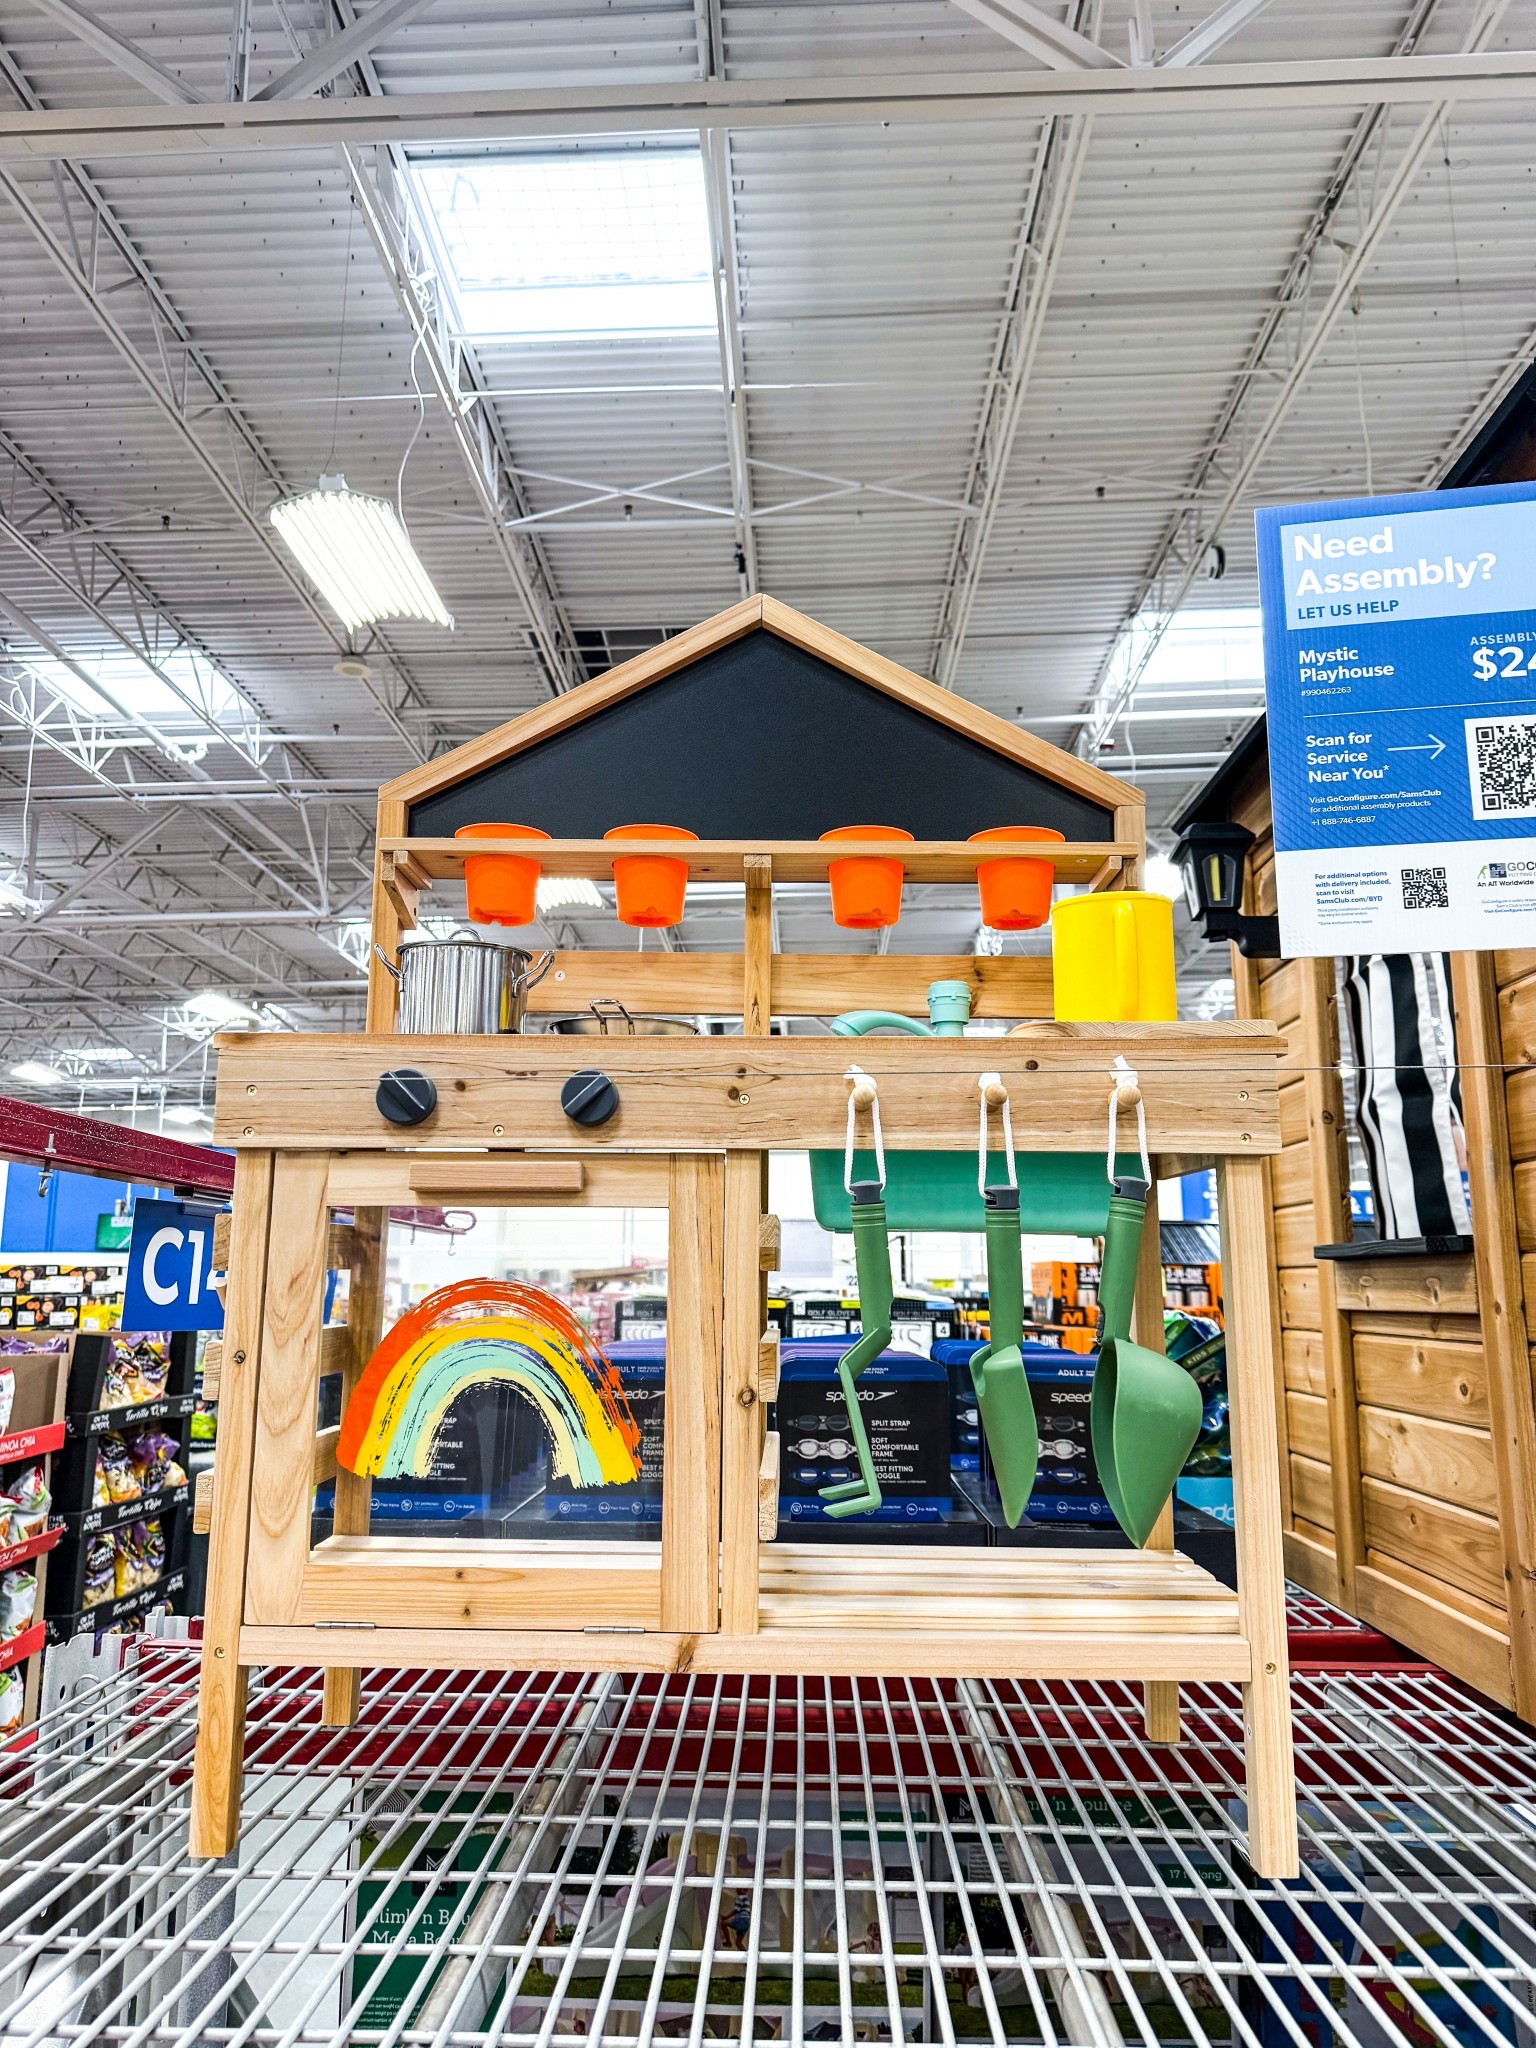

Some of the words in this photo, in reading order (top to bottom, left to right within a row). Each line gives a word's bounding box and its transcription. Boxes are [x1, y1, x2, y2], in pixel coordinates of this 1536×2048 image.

[1294, 526, 1393, 561] Need
[1296, 552, 1497, 596] Assembly?
[1298, 605, 1325, 619] LET
[1330, 603, 1352, 616] US
[1357, 600, 1399, 615] HELP
[1299, 647, 1359, 667] Mystic
[1300, 663, 1395, 684] Playhouse
[1301, 686, 1352, 697] #990462263
[1306, 734, 1345, 748] Scan
[1348, 732, 1372, 745] for
[1307, 751, 1368, 765] Service
[1308, 769, 1347, 783] Near
[1326, 789, 1441, 803] GoConfigure.com/SamsClub
[1322, 803, 1360, 812] additional
[1360, 801, 1395, 810] assembly
[1397, 800, 1431, 809] products
[1321, 816, 1376, 825] 888-746-6887
[1362, 870, 1387, 878] options
[1331, 880, 1359, 888] delivery
[126, 1408, 149, 1422] Tortilla
[1169, 1870, 1180, 1879] 17
